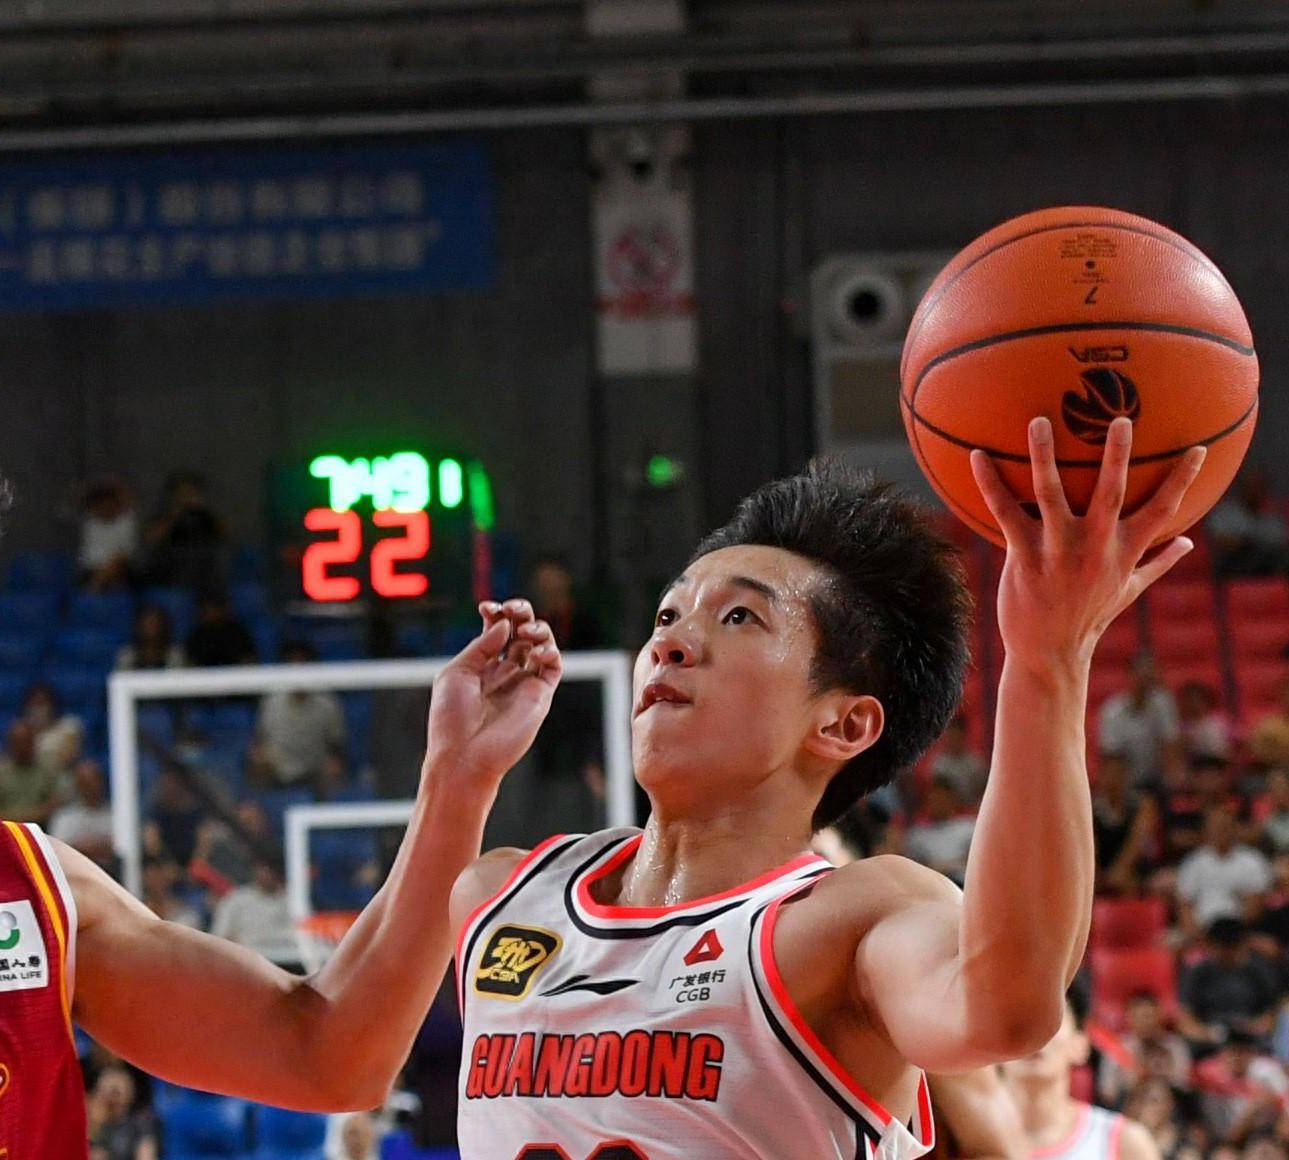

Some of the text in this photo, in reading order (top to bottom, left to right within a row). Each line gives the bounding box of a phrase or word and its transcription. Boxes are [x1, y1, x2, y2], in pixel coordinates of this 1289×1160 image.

[302, 508, 430, 602] 22
[20, 970, 42, 980] LIFE
[668, 969, 727, 990] 广发银行
[675, 986, 711, 1004] CGB
[466, 1029, 725, 1102] GUANGDONG
